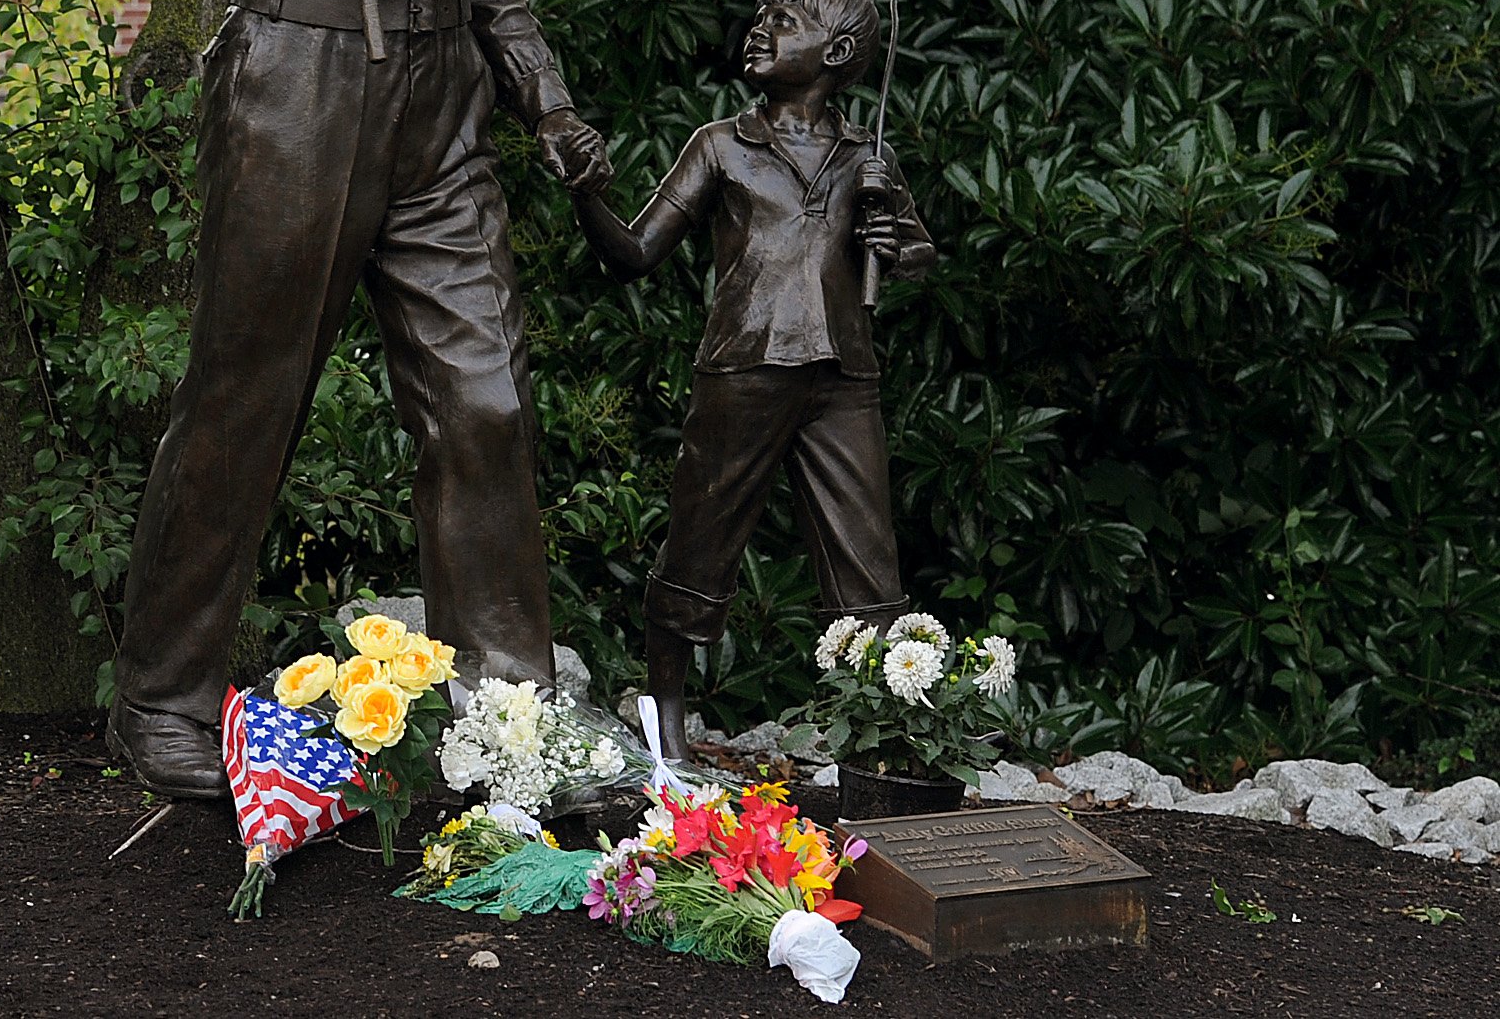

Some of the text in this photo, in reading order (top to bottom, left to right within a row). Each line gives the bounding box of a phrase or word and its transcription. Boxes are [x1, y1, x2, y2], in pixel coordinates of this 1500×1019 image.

[880, 828, 933, 842] Andy
[932, 820, 1012, 837] Griffith
[1006, 817, 1062, 830] Show
